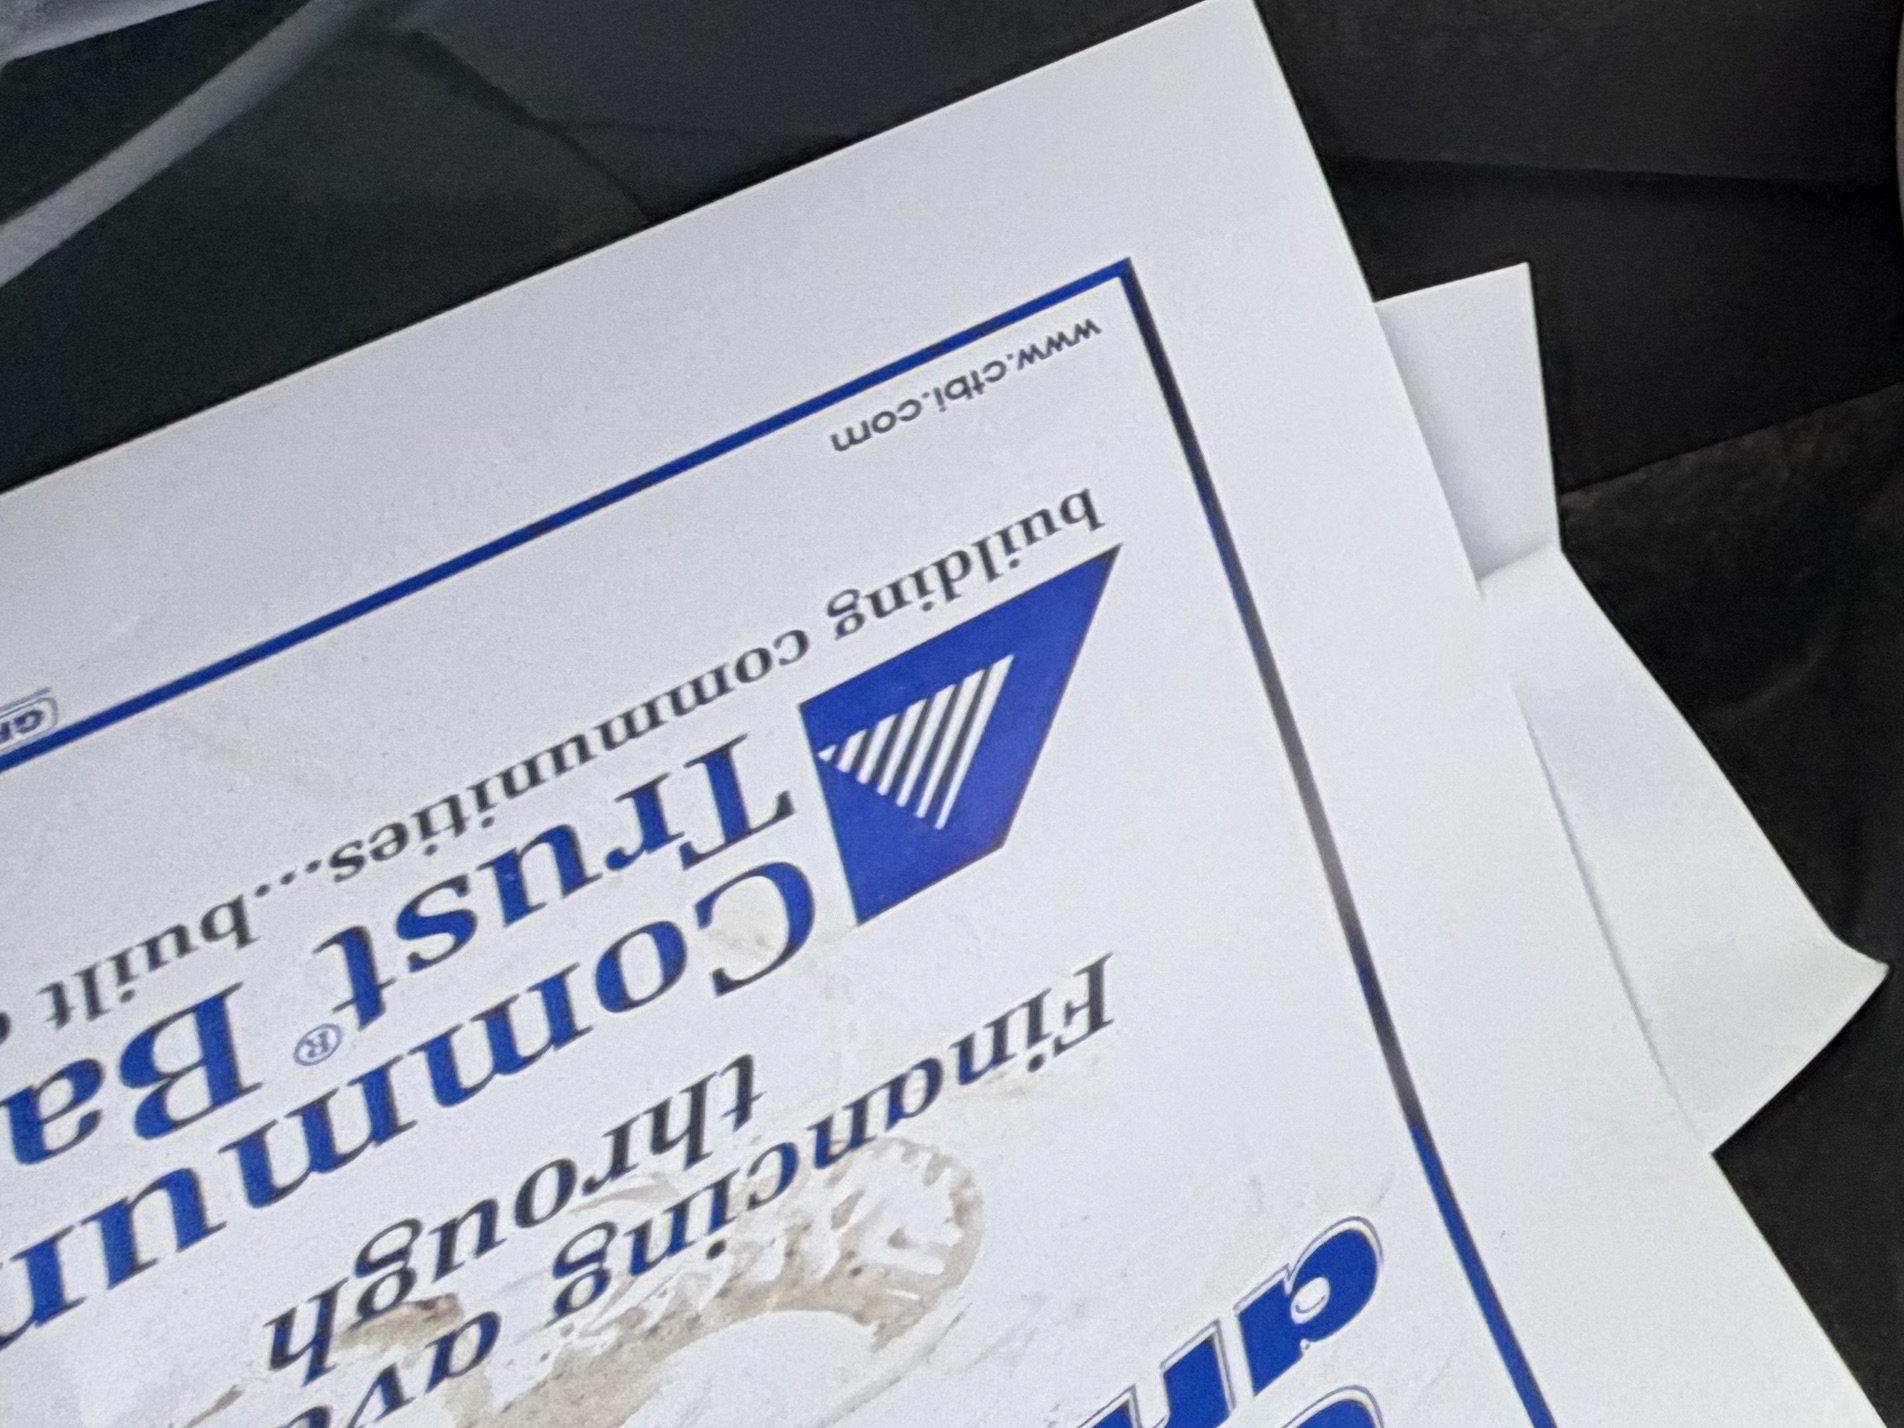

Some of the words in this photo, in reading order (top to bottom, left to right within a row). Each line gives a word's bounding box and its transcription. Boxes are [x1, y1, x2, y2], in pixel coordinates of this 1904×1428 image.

[829, 318, 1102, 457] www.ctbi.com
[825, 488, 1107, 643] building
[263, 1053, 766, 1387] through
[546, 953, 1114, 1325] Financing
